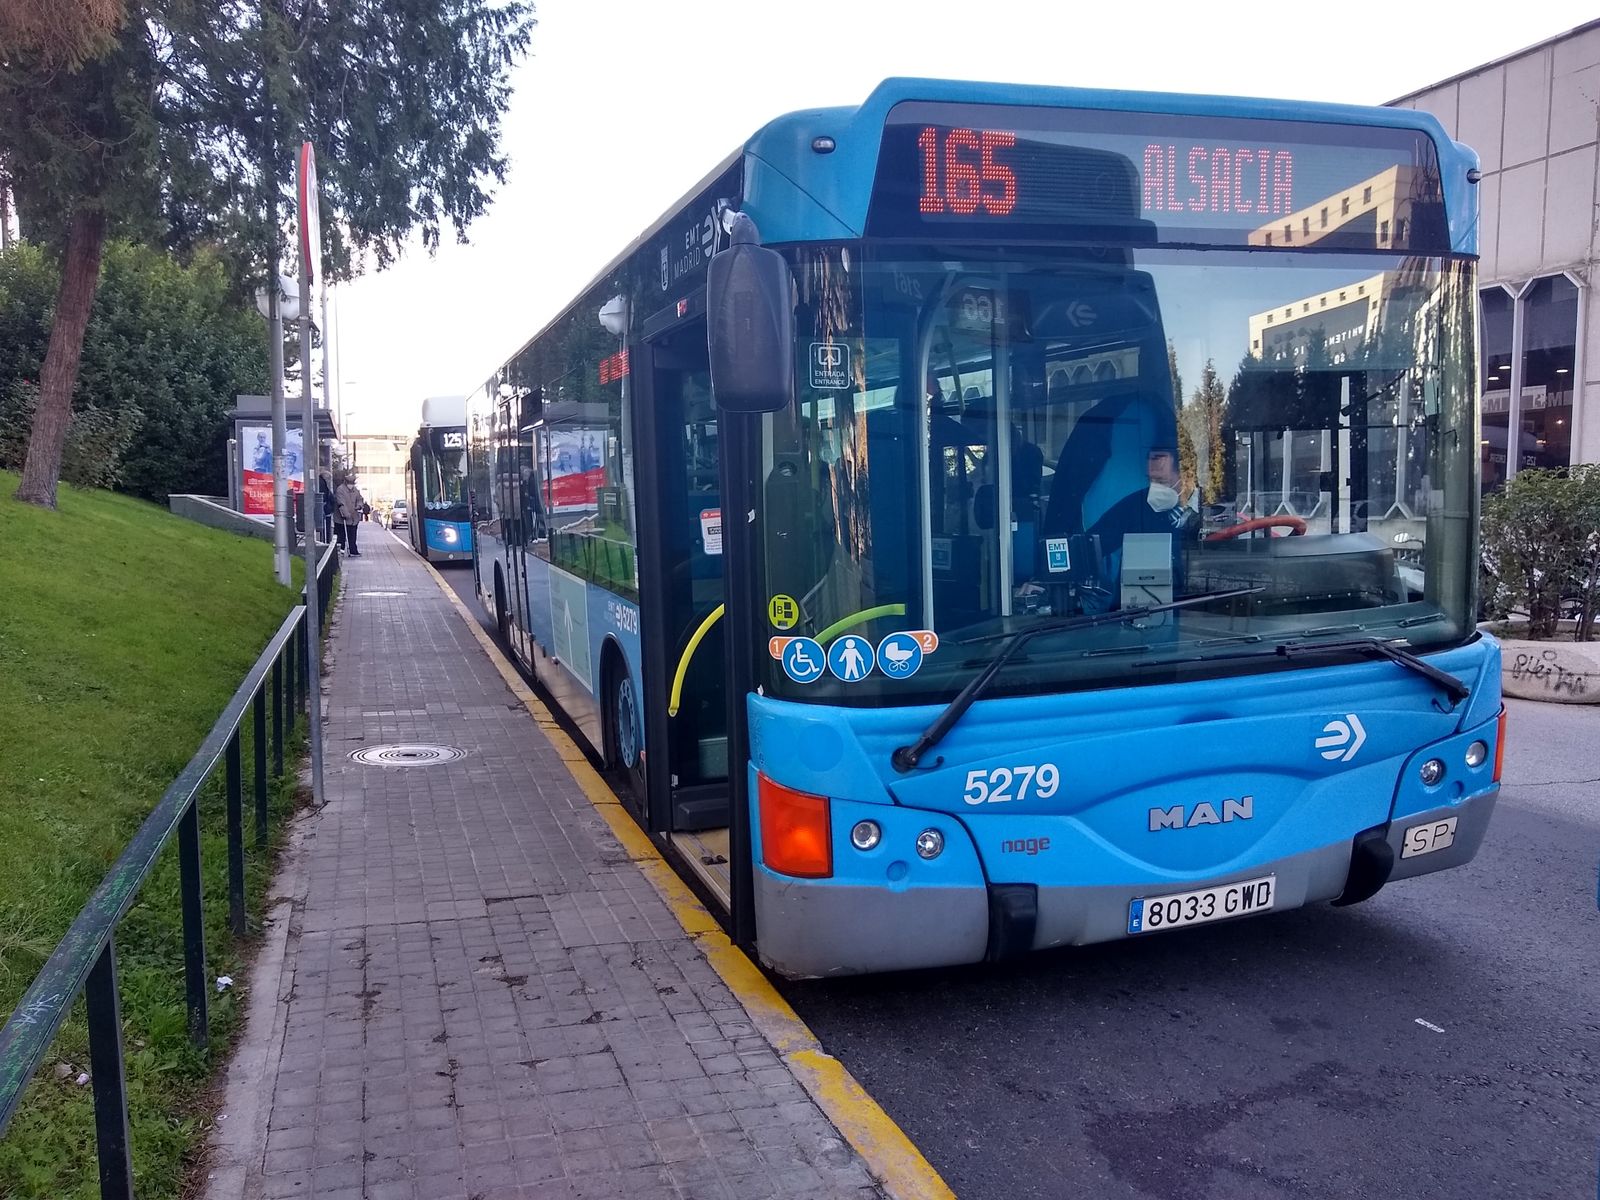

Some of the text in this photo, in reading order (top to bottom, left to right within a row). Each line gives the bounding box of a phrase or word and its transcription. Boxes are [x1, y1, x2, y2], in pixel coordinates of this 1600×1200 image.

[917, 126, 1293, 216] 165 ALSACIA
[685, 222, 701, 251] EMT
[673, 246, 702, 281] MADRID
[814, 370, 846, 378] ENTRADA
[814, 378, 846, 386] ENTRANCE
[443, 432, 463, 448] 125
[1048, 542, 1067, 551] EMT
[622, 604, 638, 636] 5279
[776, 605, 784, 615] B
[773, 639, 780, 653] 1
[922, 634, 933, 648] 2
[962, 763, 1061, 805] 5279
[1148, 796, 1254, 832] MAN
[1001, 835, 1051, 857] noge
[1412, 823, 1449, 852] SP
[1148, 881, 1271, 927] 8033 GWD
